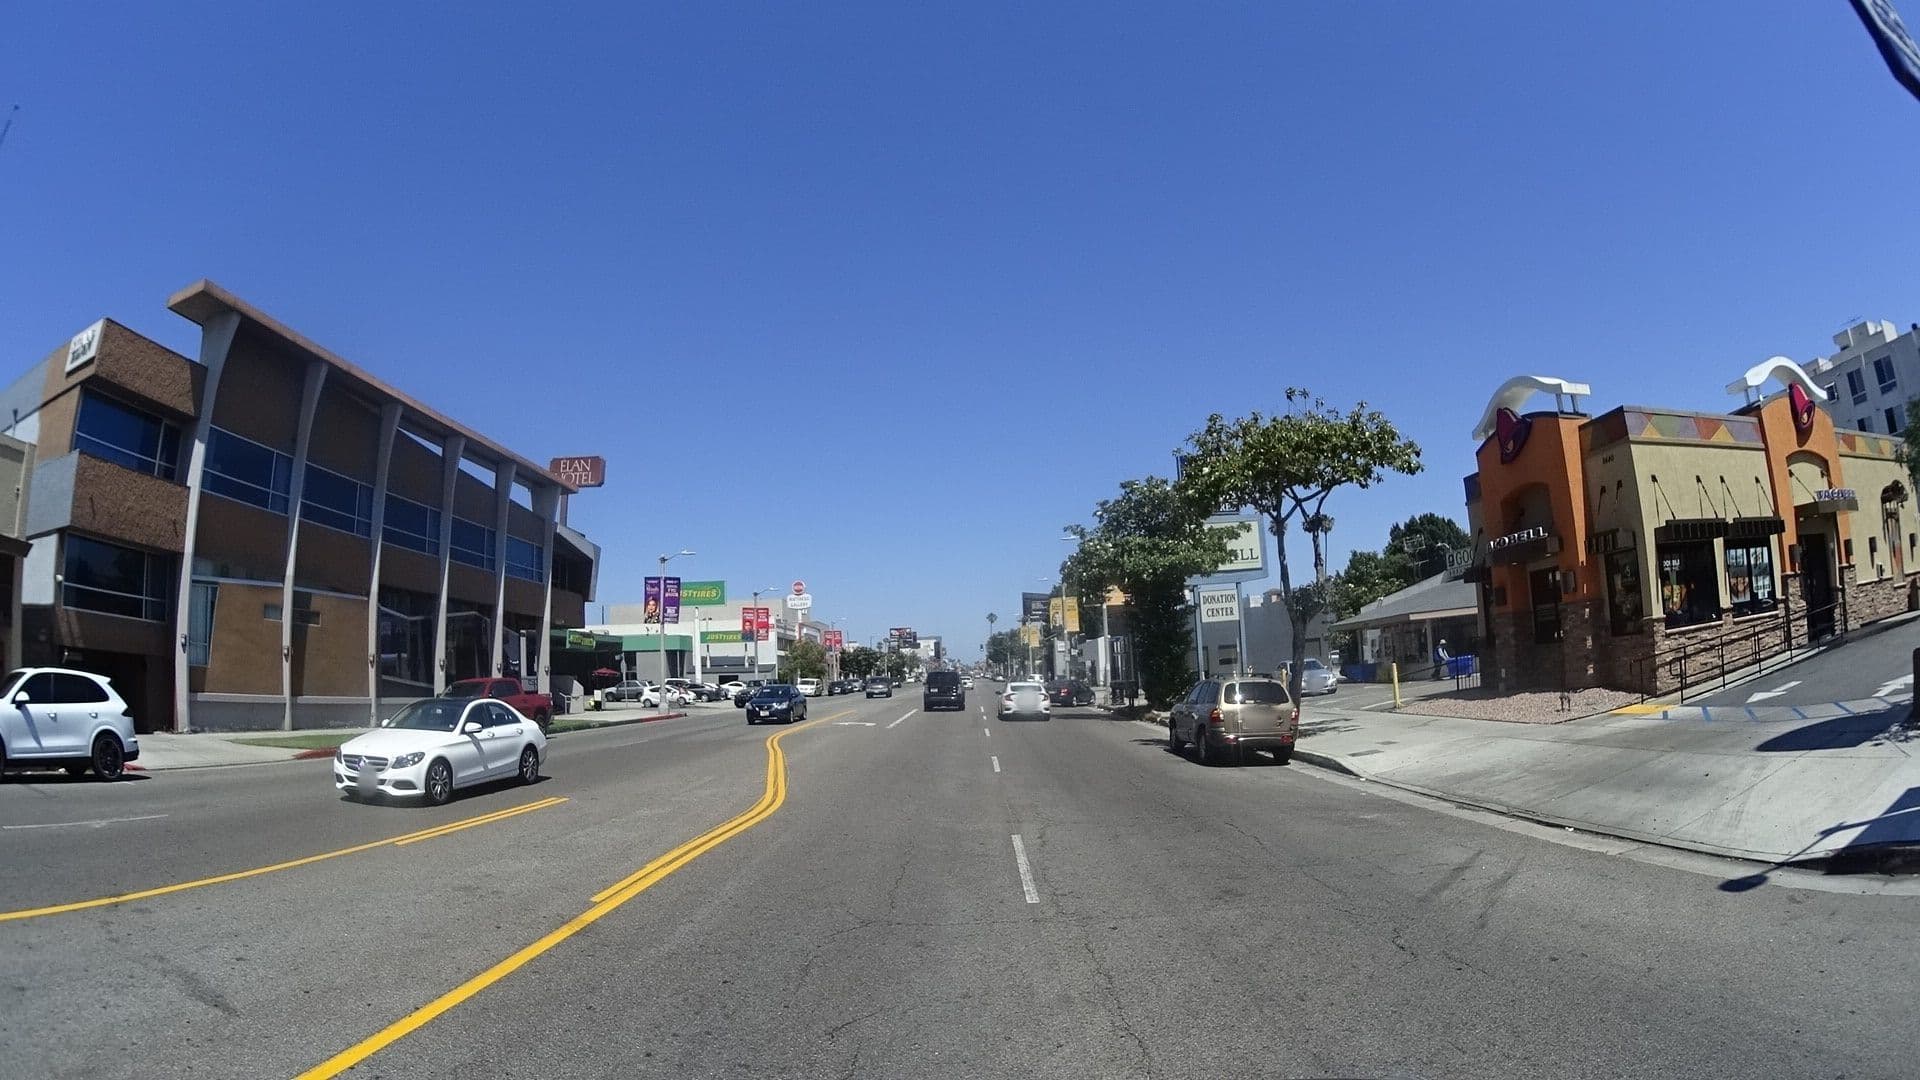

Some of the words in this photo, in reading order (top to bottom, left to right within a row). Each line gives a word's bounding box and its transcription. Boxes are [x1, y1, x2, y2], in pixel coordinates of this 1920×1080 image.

[560, 459, 591, 472] ELAN
[560, 471, 595, 485] OTEL
[1202, 593, 1236, 605] DONATION
[1206, 607, 1234, 617] CENTER
